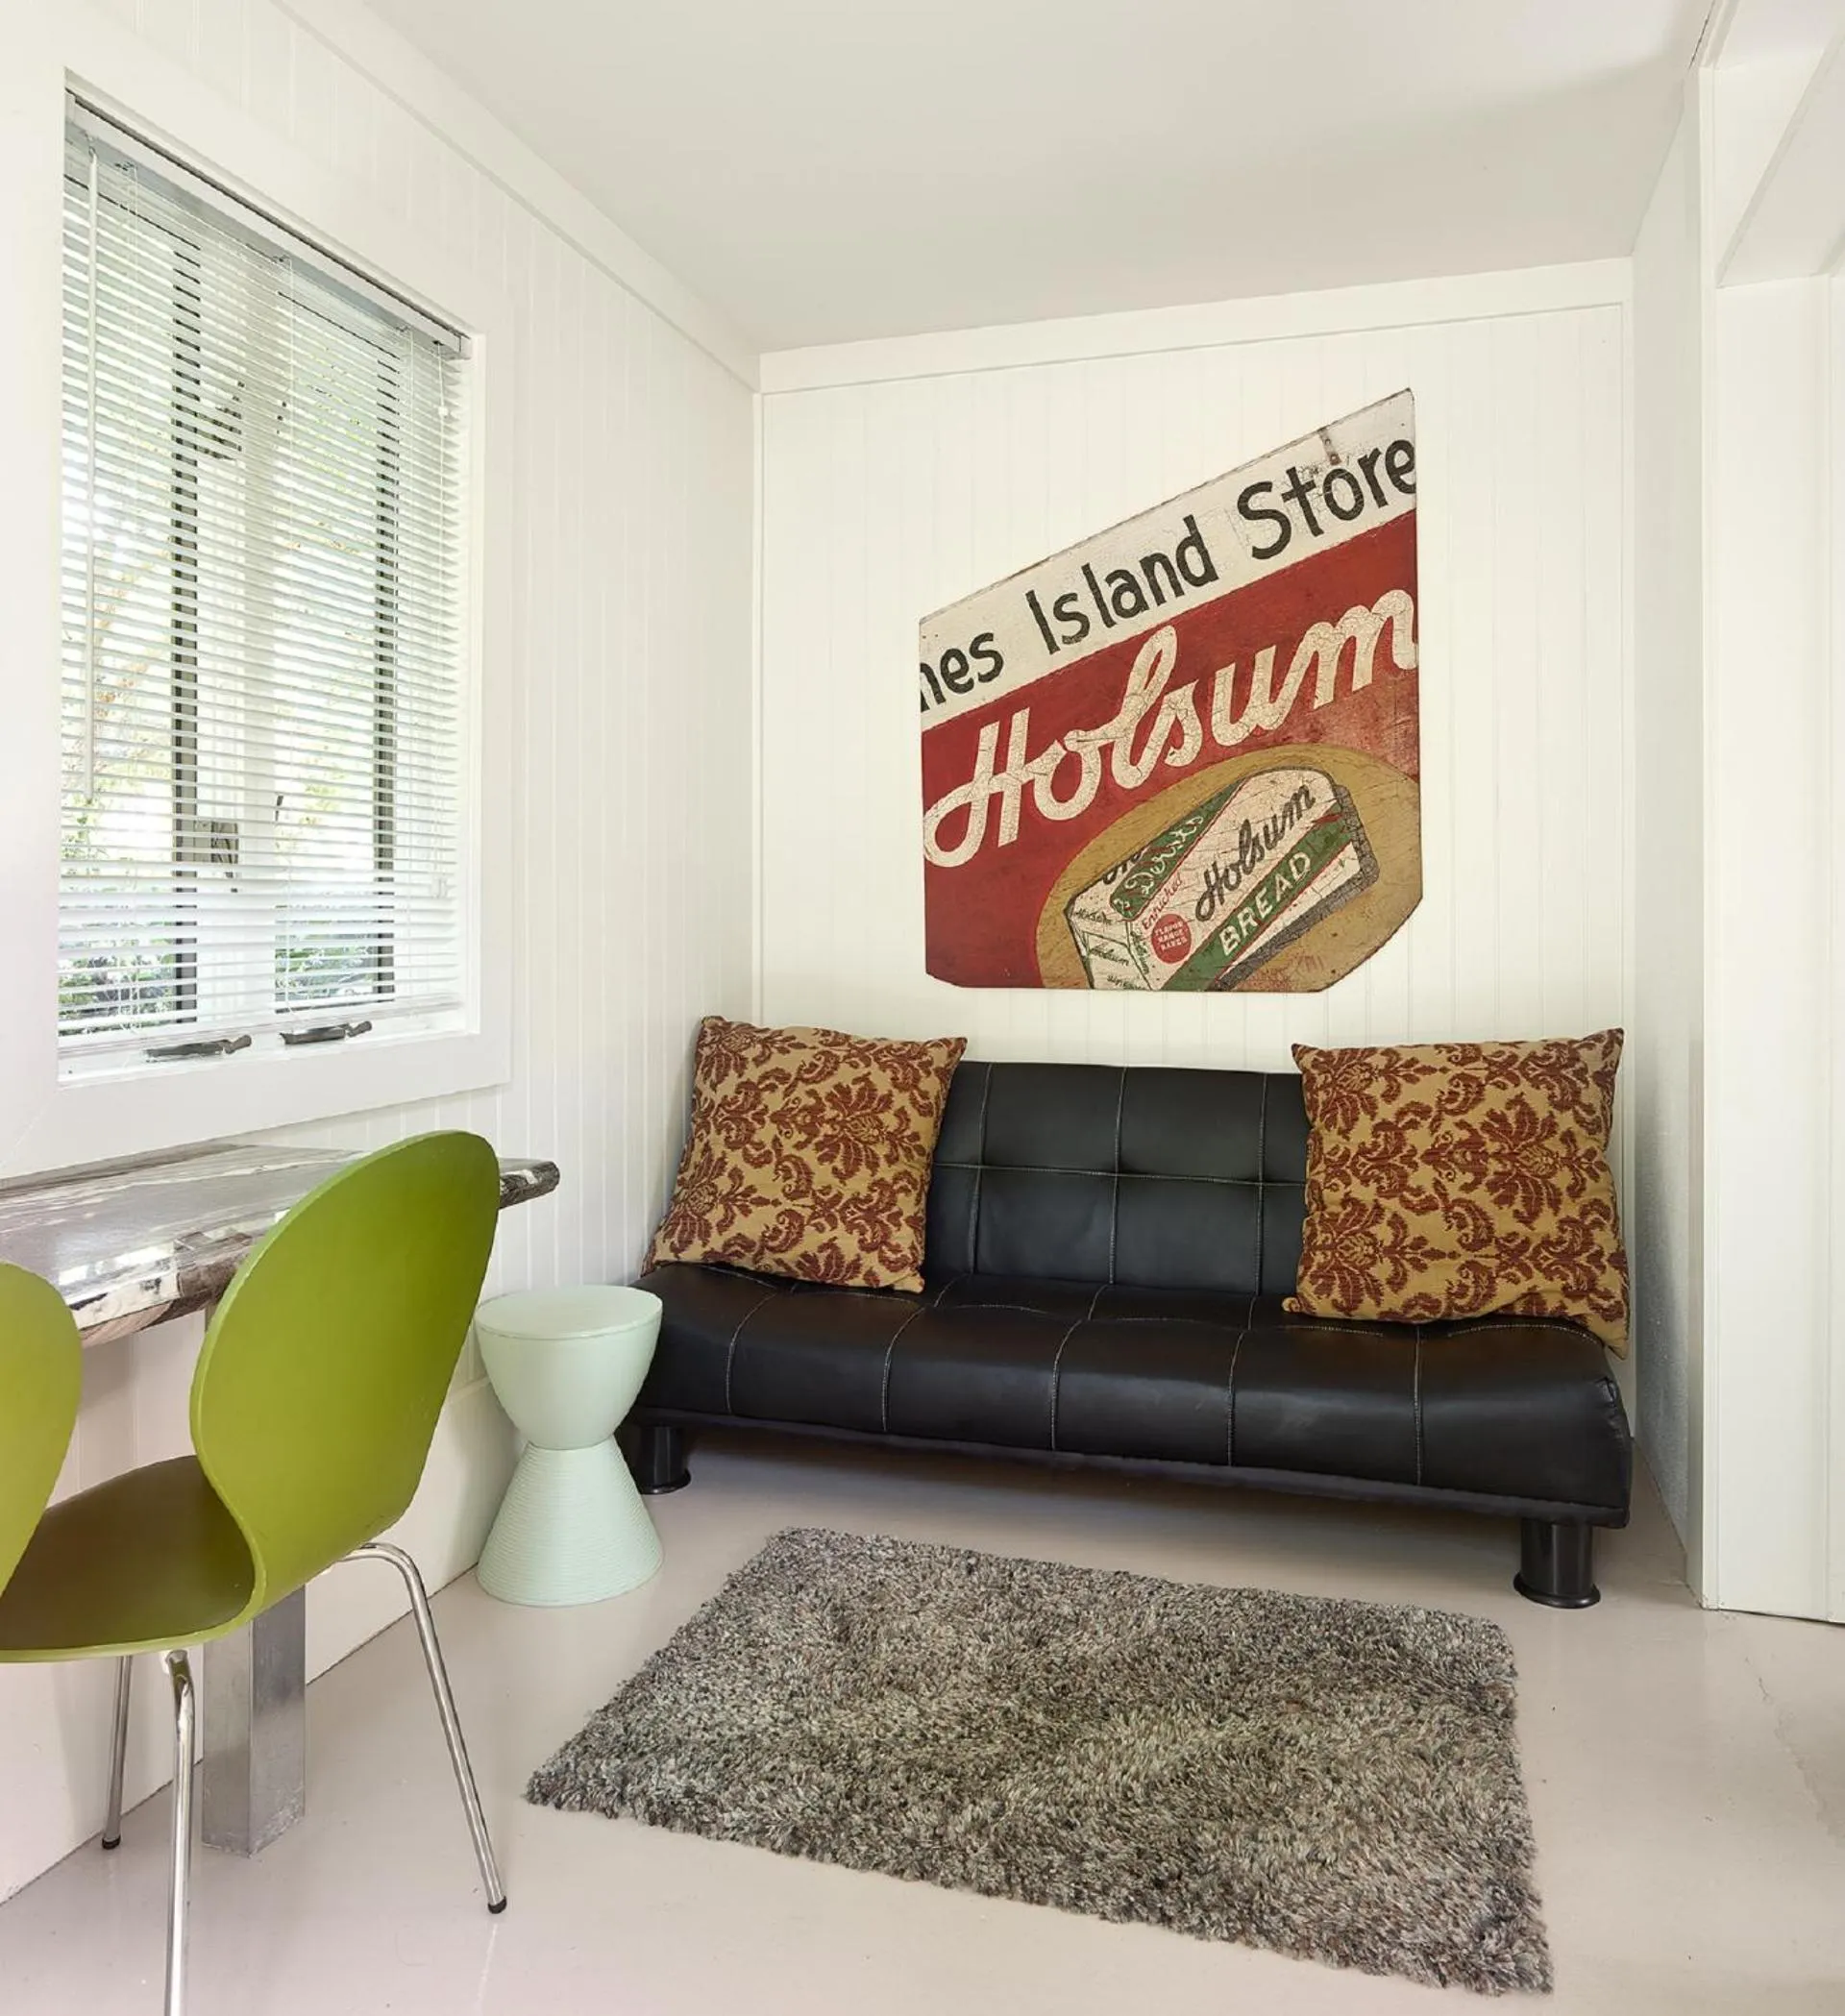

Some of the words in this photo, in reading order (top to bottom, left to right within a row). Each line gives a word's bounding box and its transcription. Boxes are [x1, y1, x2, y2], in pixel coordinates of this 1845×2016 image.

[1026, 515, 1219, 654] Island
[1237, 439, 1416, 560] Store
[923, 589, 1418, 869] Holsum
[1195, 784, 1316, 922] Holsum
[1218, 851, 1312, 956] BREAD
